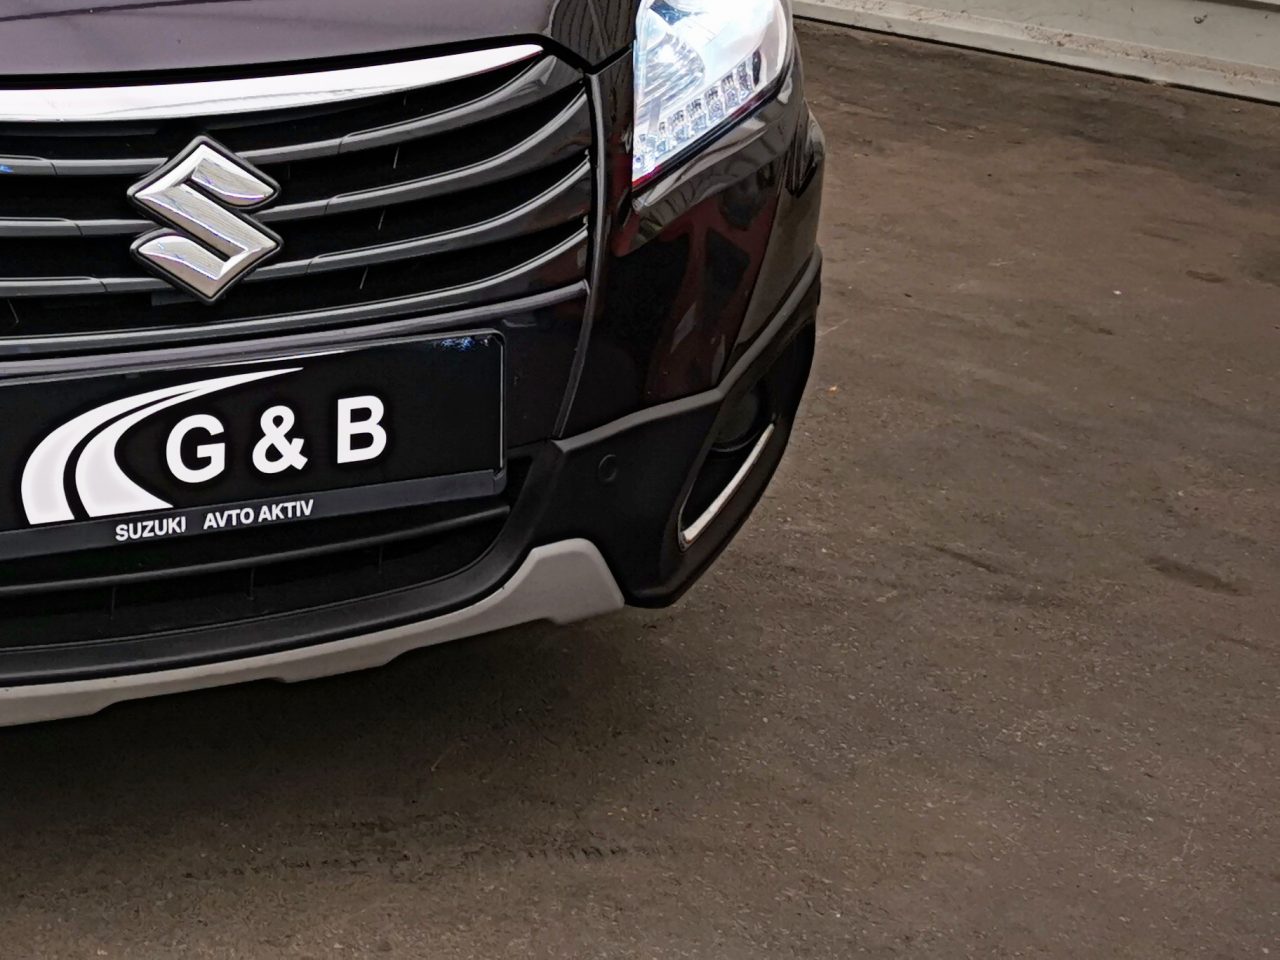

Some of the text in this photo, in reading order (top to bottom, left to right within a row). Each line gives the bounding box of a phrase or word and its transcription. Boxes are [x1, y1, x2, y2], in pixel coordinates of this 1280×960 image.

[165, 395, 387, 484] G & B
[115, 498, 314, 542] SUZUKI AVTO AKTIV
